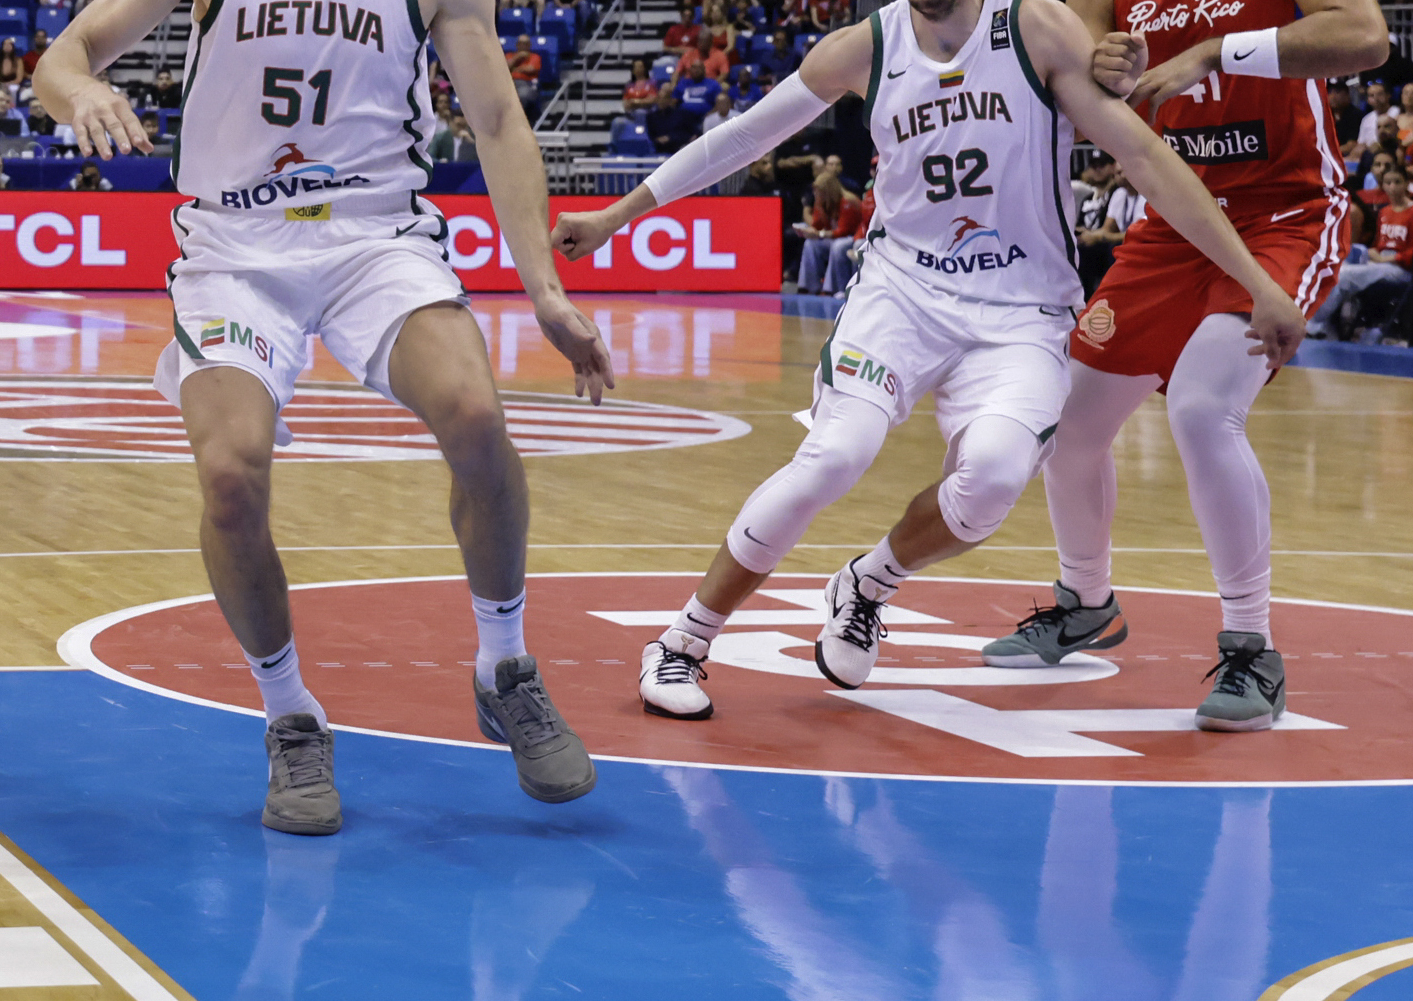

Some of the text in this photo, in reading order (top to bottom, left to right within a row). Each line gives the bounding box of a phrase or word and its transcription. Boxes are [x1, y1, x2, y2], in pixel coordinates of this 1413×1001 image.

[236, 0, 385, 54] LIETUVA
[993, 30, 1007, 40] FIBA
[1127, 0, 1189, 34] Puerto
[261, 67, 332, 128] 51
[1178, 69, 1222, 104] 41
[892, 91, 1013, 144] LIETUVA
[221, 174, 371, 210] BIOVELA
[922, 148, 994, 203] 92
[915, 244, 1028, 275] BIOVELA
